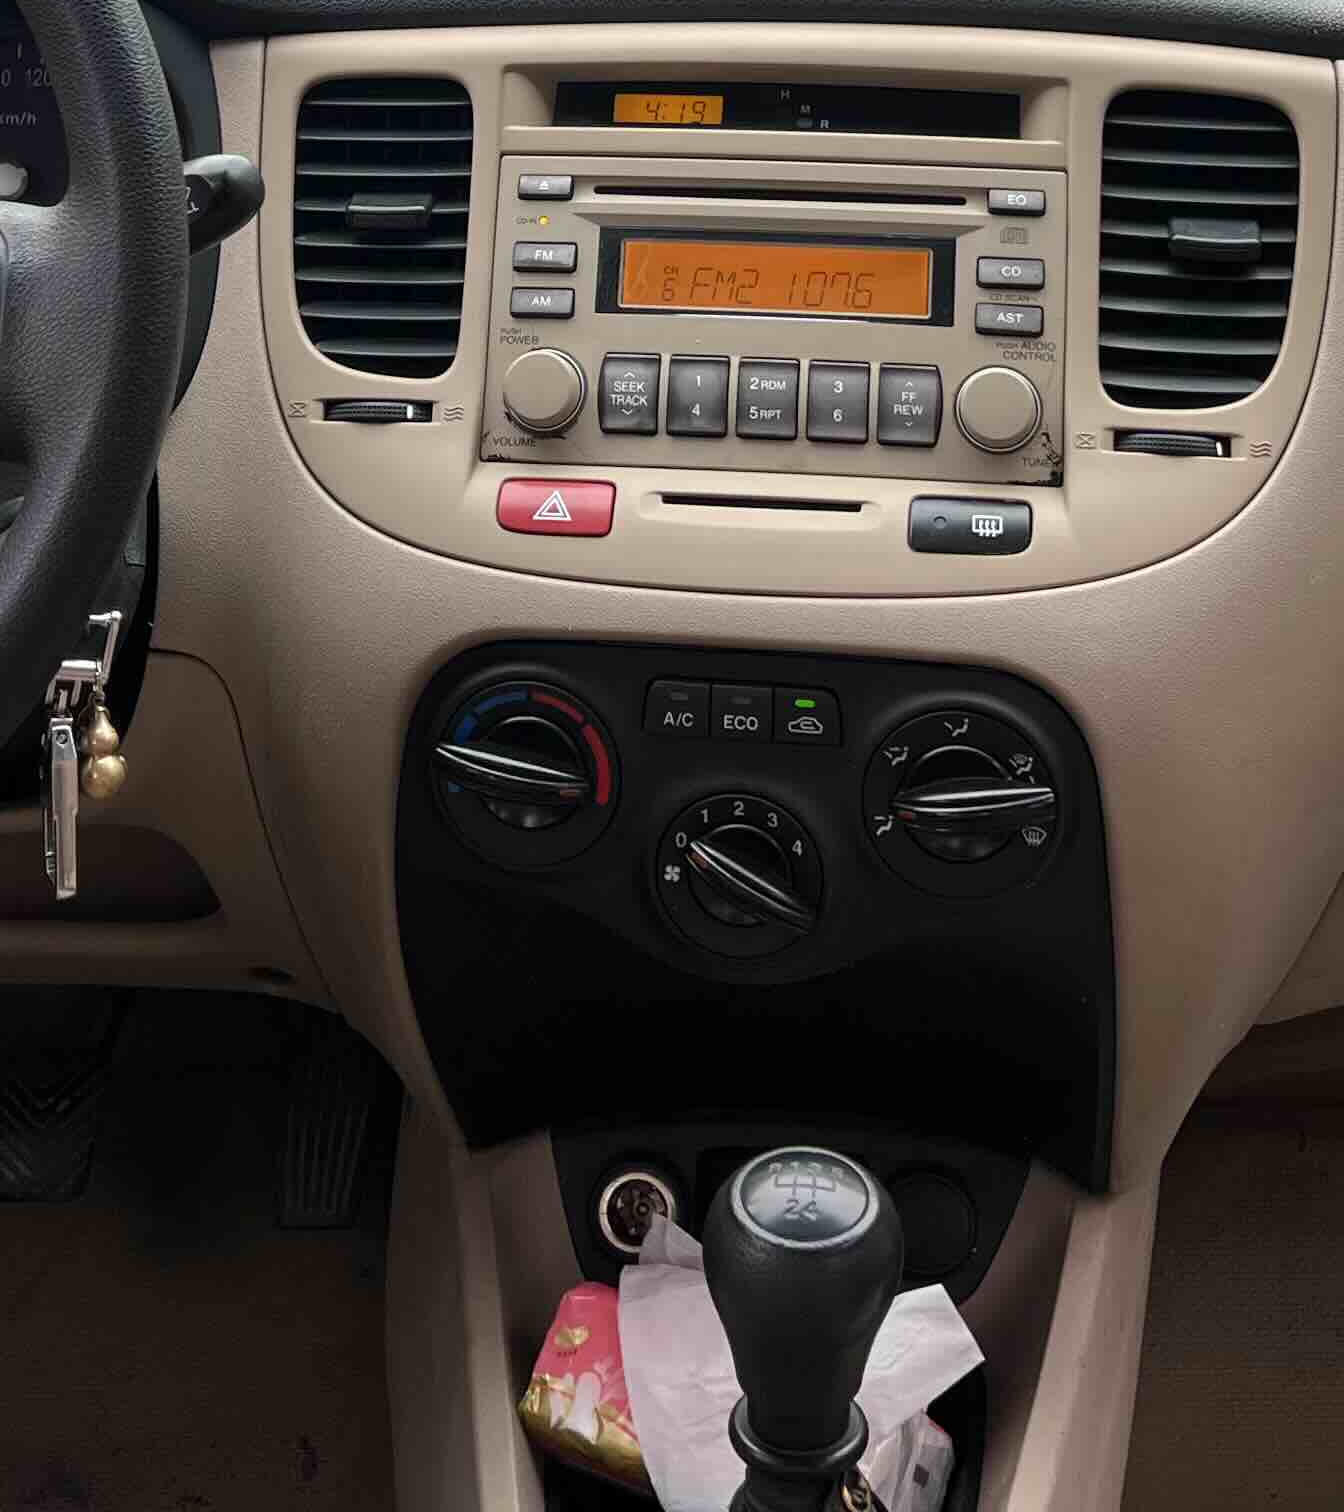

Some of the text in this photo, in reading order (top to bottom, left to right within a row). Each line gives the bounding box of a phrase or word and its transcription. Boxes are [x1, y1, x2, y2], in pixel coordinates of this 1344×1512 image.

[819, 119, 830, 129] R
[534, 250, 553, 261] FM
[1001, 265, 1022, 277] CD
[689, 267, 760, 305] FM2
[531, 295, 552, 306] AM
[996, 312, 1025, 324] AST
[500, 335, 539, 345] POWER
[1020, 340, 1056, 351] AUDIO
[1002, 350, 1057, 362] CONTROL
[613, 381, 645, 393] SEEK
[695, 375, 703, 387] 1
[832, 380, 844, 394] 3
[609, 394, 648, 408] TRACK
[901, 391, 917, 403] FF
[690, 403, 702, 417] 4
[832, 409, 844, 422] 6
[893, 403, 924, 416] REW
[493, 436, 538, 447] VOLUME
[663, 711, 694, 727] A/C
[723, 714, 759, 730] ECO
[733, 800, 745, 816] 2
[700, 808, 709, 823] 1
[767, 812, 778, 828] 3
[675, 832, 688, 849] 0
[791, 839, 803, 856] 4
[784, 1198, 800, 1220] 2
